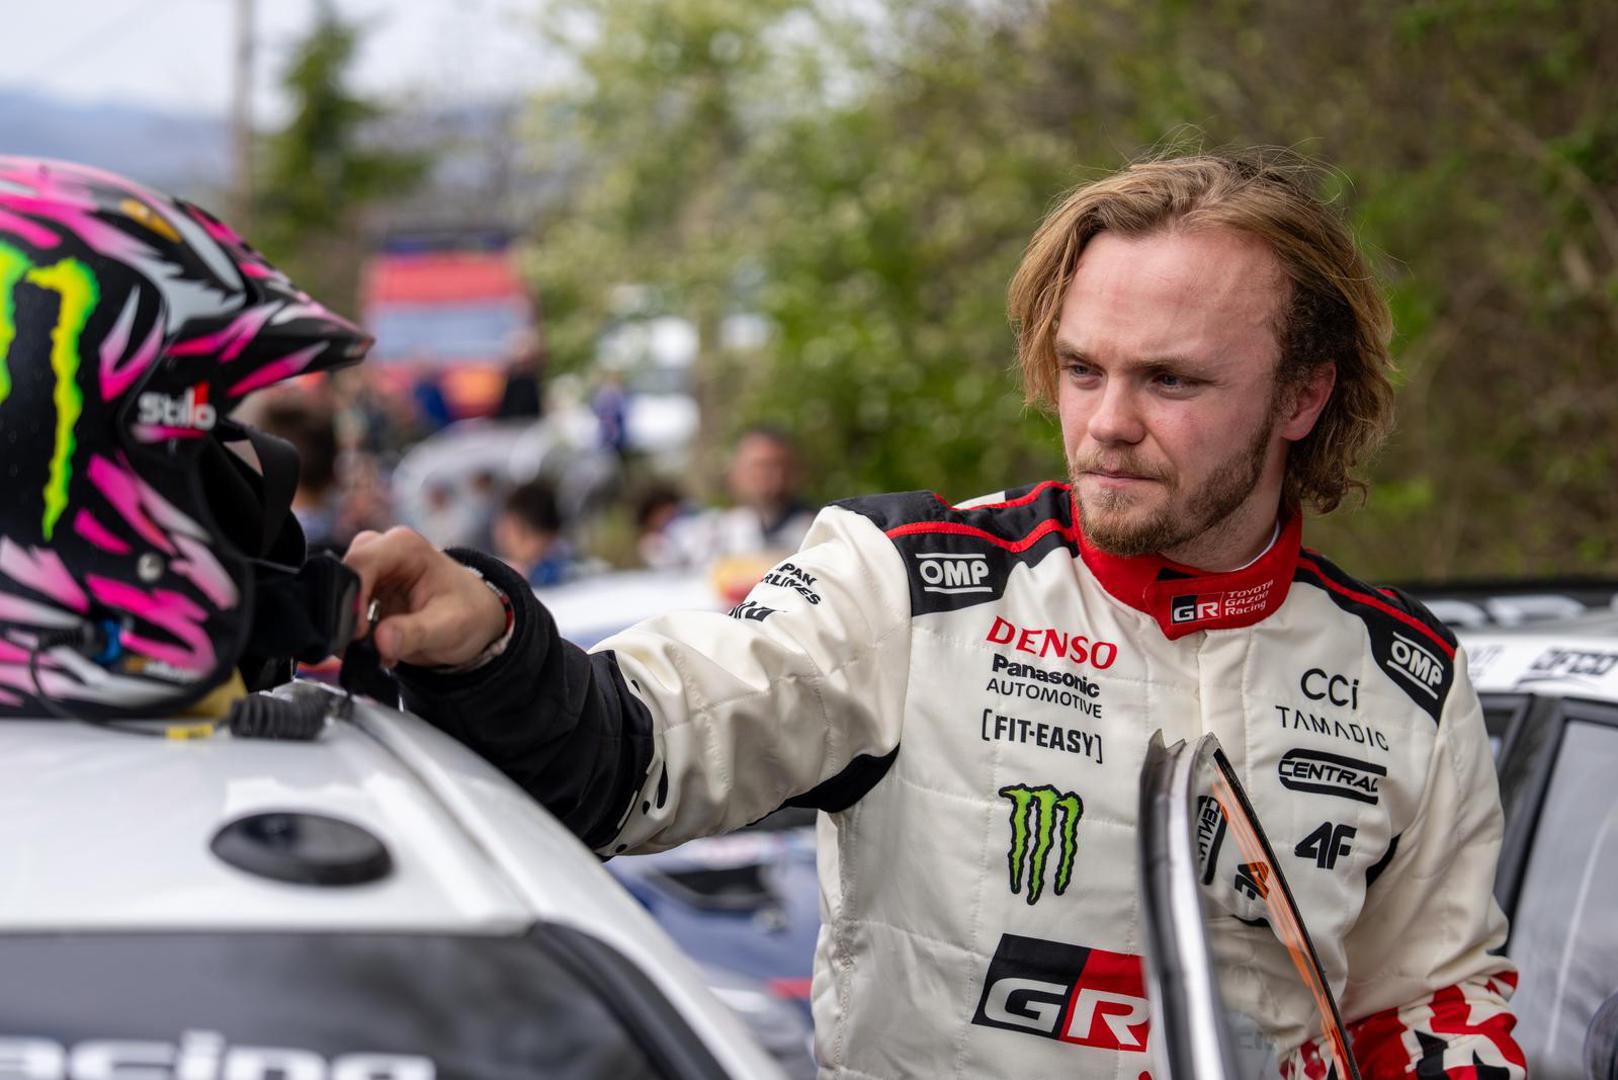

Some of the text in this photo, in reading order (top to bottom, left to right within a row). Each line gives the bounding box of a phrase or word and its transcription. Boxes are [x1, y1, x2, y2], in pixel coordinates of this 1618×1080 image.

[137, 380, 217, 431] Stilo
[777, 562, 818, 586] PAN
[919, 560, 990, 587] OMP
[1227, 579, 1274, 598] TOYOTA
[1173, 602, 1219, 622] GR
[1224, 590, 1269, 607] GAZOO
[1225, 600, 1267, 616] Racing
[985, 615, 1118, 670] DENSO
[991, 653, 1101, 698] Panasonic
[1390, 640, 1443, 688] OMP
[985, 677, 1103, 719] AUTOMOTIVE
[1275, 704, 1390, 752] TAMADIC
[1278, 759, 1379, 793] CENTRAL
[1294, 821, 1358, 870] 4F
[983, 977, 1150, 1047] GR
